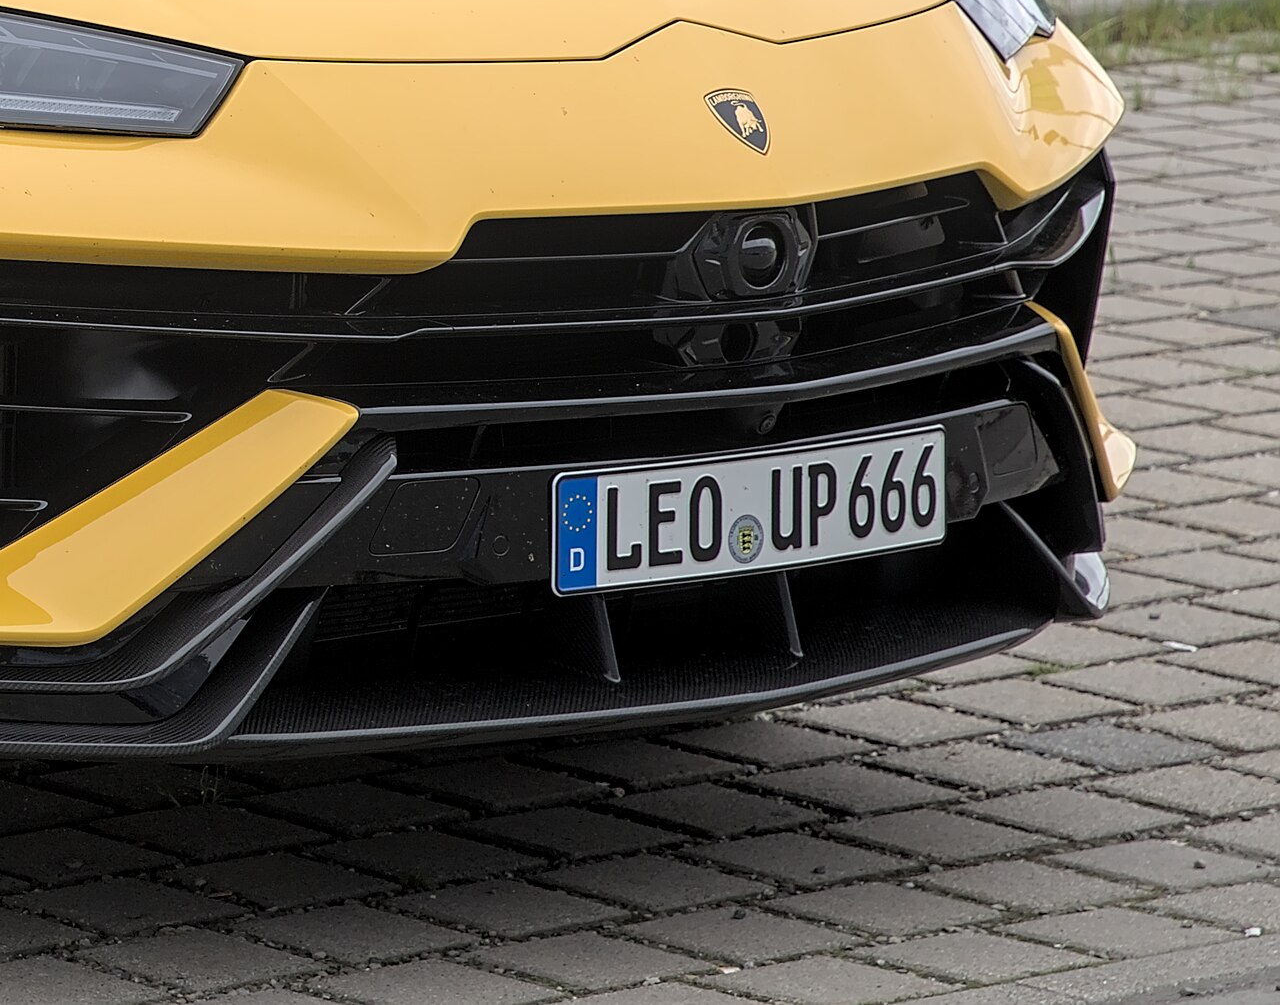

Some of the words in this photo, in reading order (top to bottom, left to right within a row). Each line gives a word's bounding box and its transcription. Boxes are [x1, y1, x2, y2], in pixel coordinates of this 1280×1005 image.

[606, 475, 723, 571] LEO
[770, 462, 837, 551] UP
[849, 444, 936, 539] 666
[569, 547, 585, 572] D
